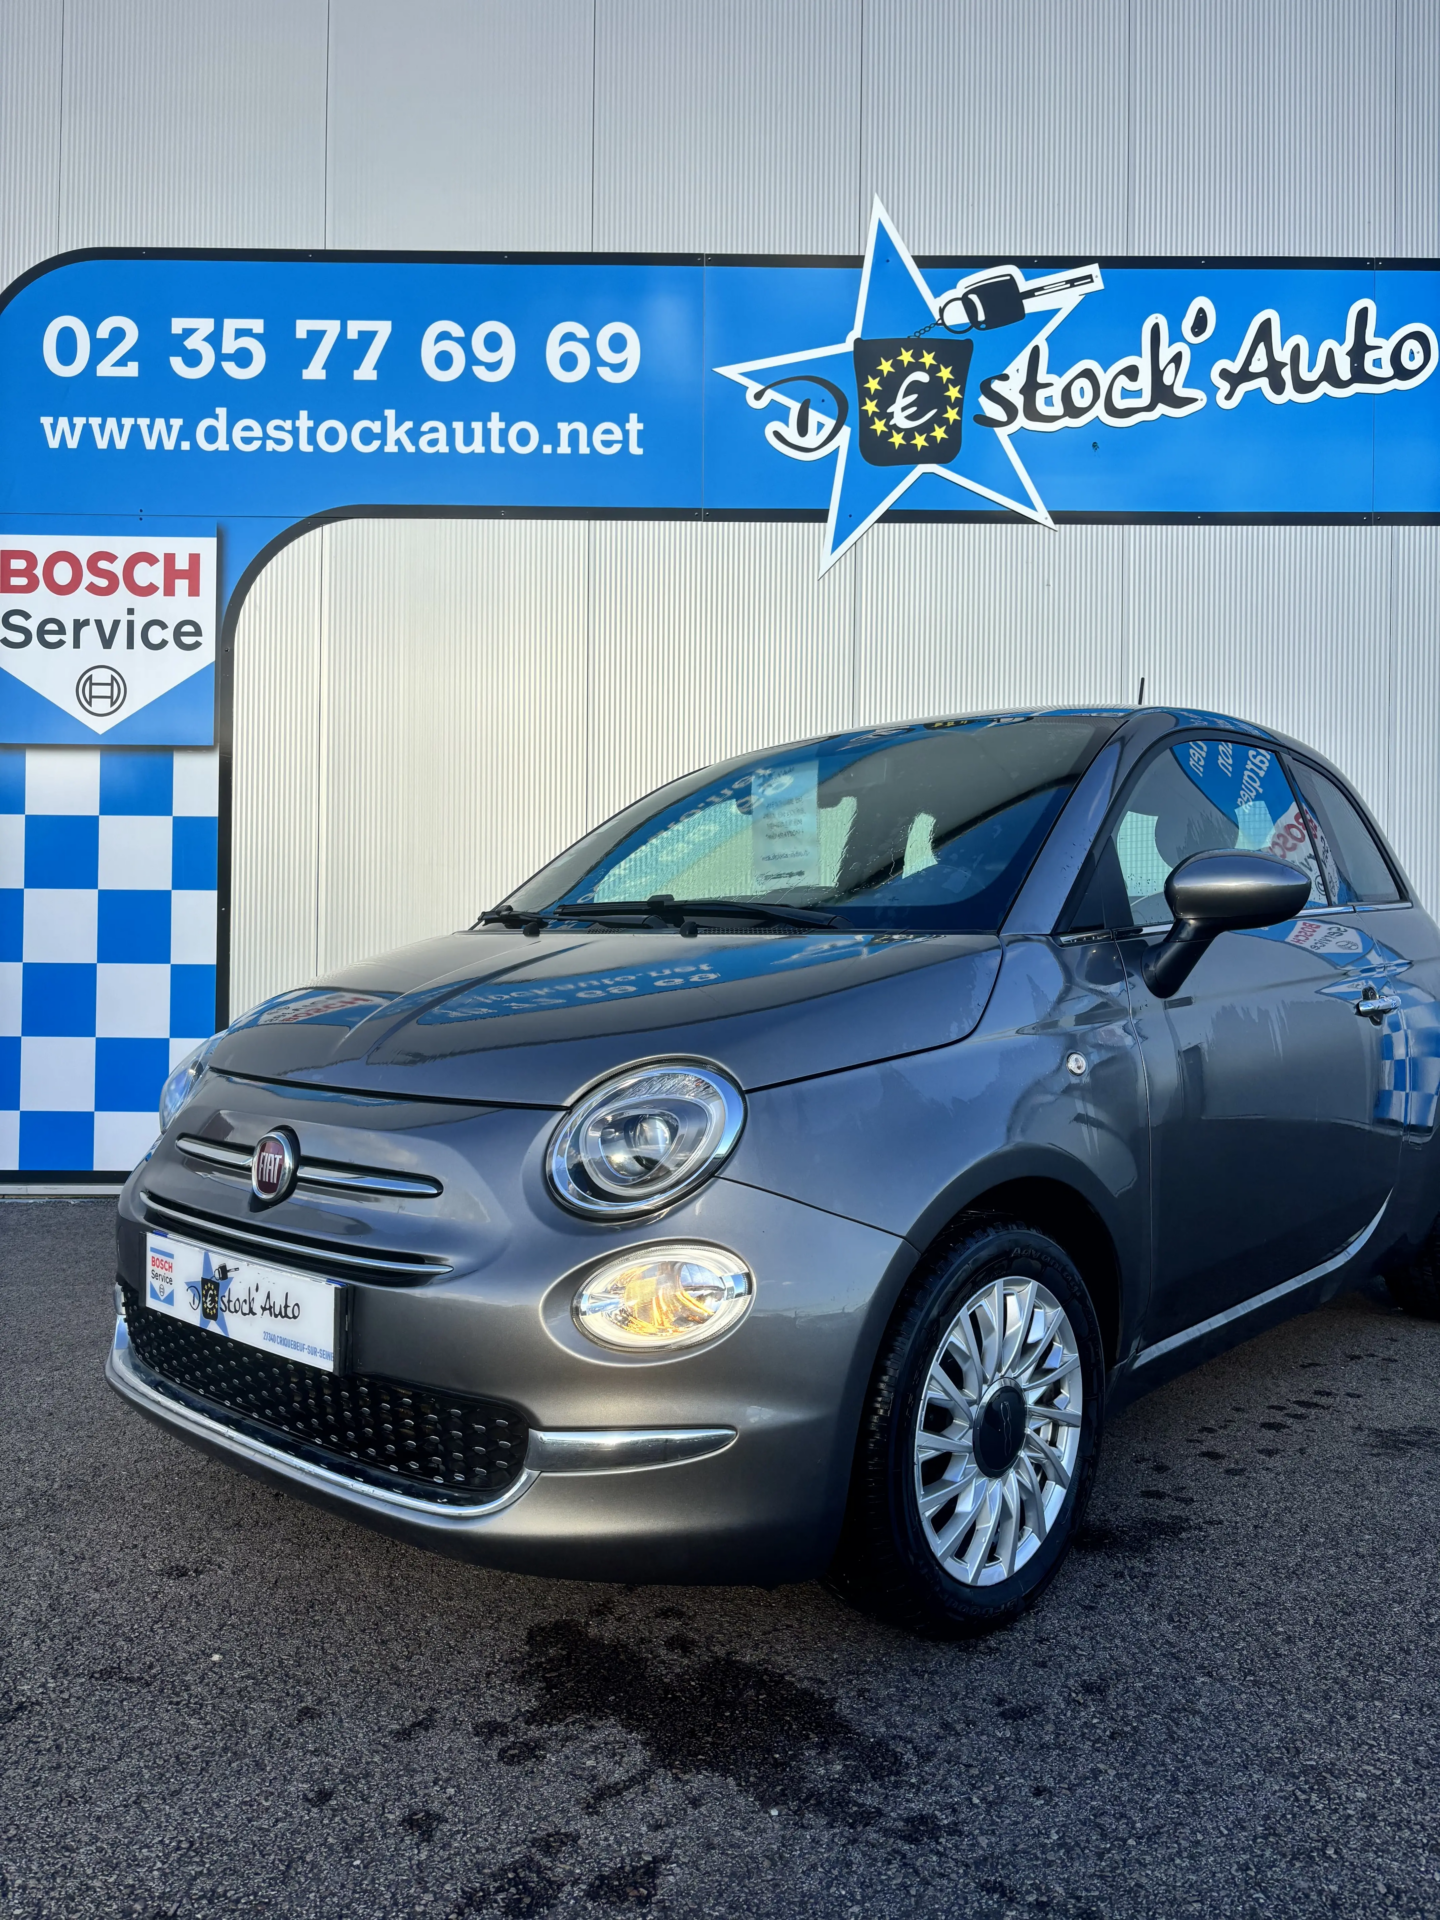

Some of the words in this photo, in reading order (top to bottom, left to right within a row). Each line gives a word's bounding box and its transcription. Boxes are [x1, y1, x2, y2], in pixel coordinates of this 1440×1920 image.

[42, 315, 139, 378] 02
[169, 317, 266, 380] 35
[295, 319, 392, 381] 77
[420, 320, 516, 383] 69
[545, 321, 641, 384] 69
[40, 407, 644, 455] www.destockauto.net
[0, 550, 201, 597] BOSCH
[0, 608, 203, 651] Service
[258, 1152, 283, 1184] FIAT
[151, 1256, 173, 1273] BOSCH
[151, 1269, 173, 1285] Service
